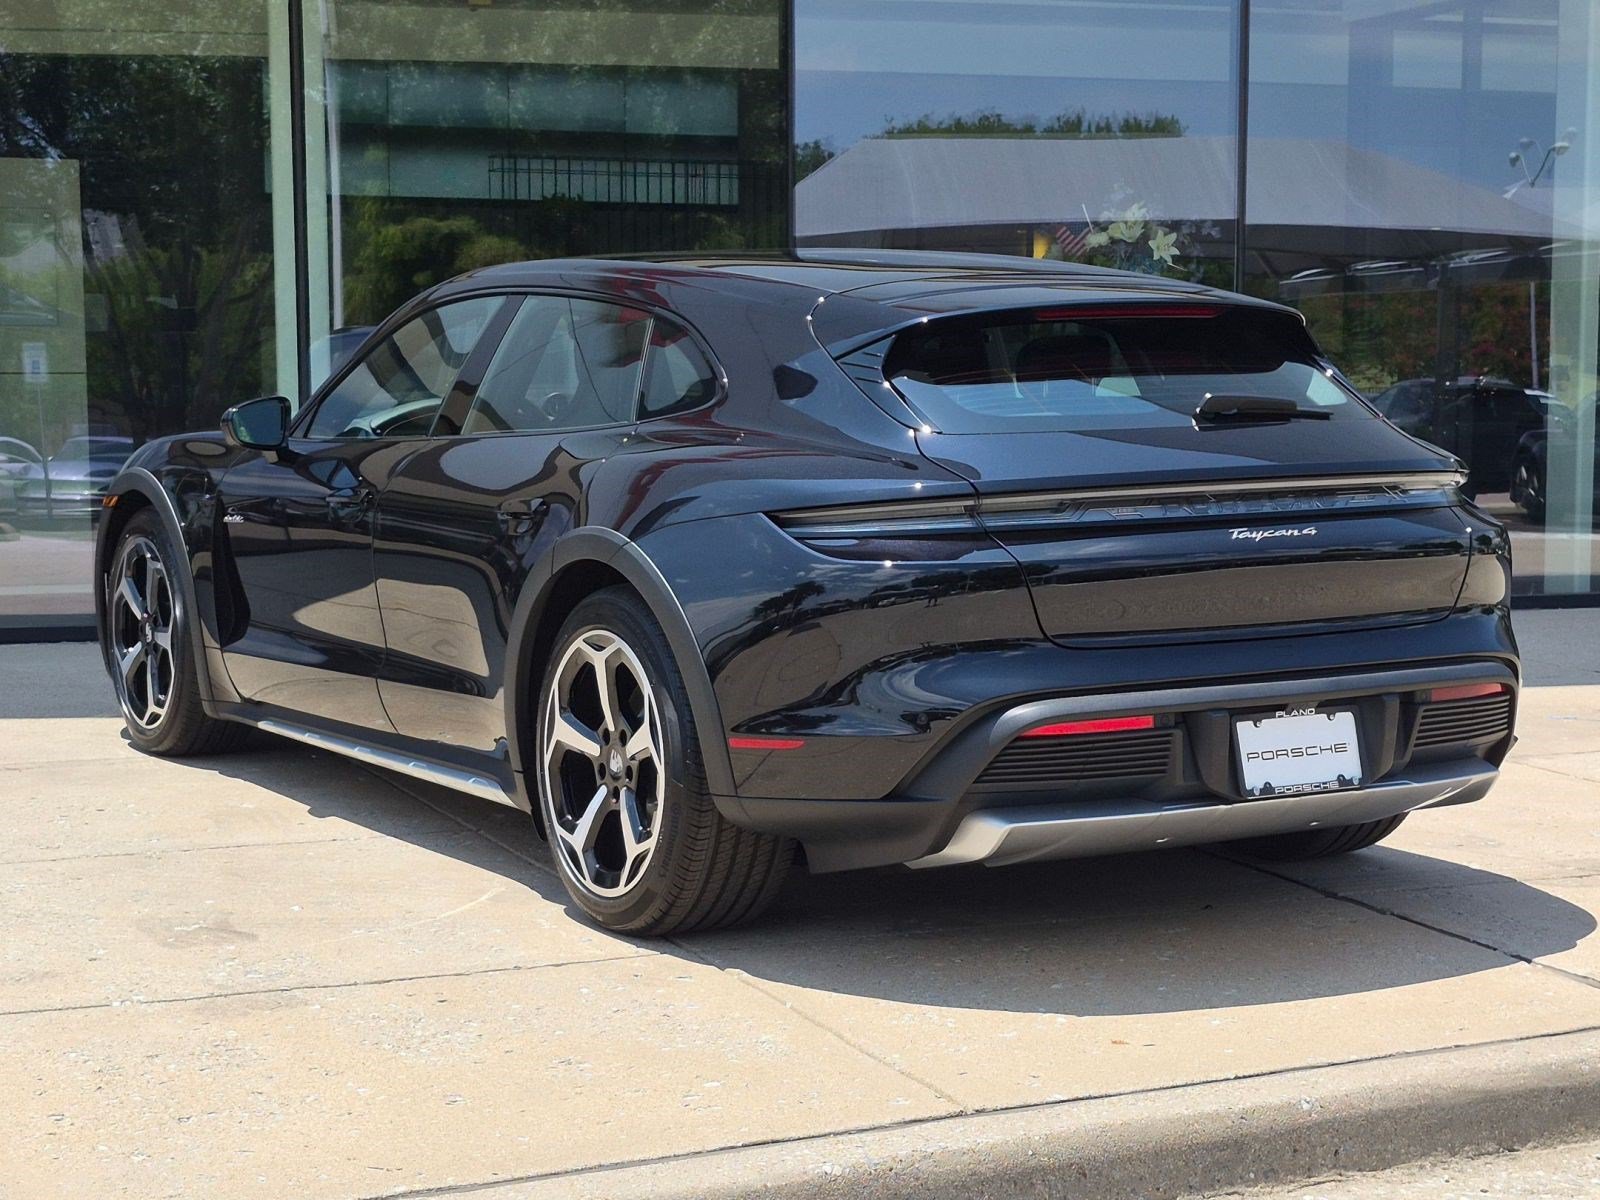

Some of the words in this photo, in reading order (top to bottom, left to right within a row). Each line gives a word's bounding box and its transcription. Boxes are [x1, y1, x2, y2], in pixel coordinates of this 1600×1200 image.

[1229, 527, 1300, 541] Taycan
[1275, 707, 1316, 718] PLANO
[1247, 742, 1348, 762] PORSCHE
[1275, 781, 1340, 795] PORSCHE
